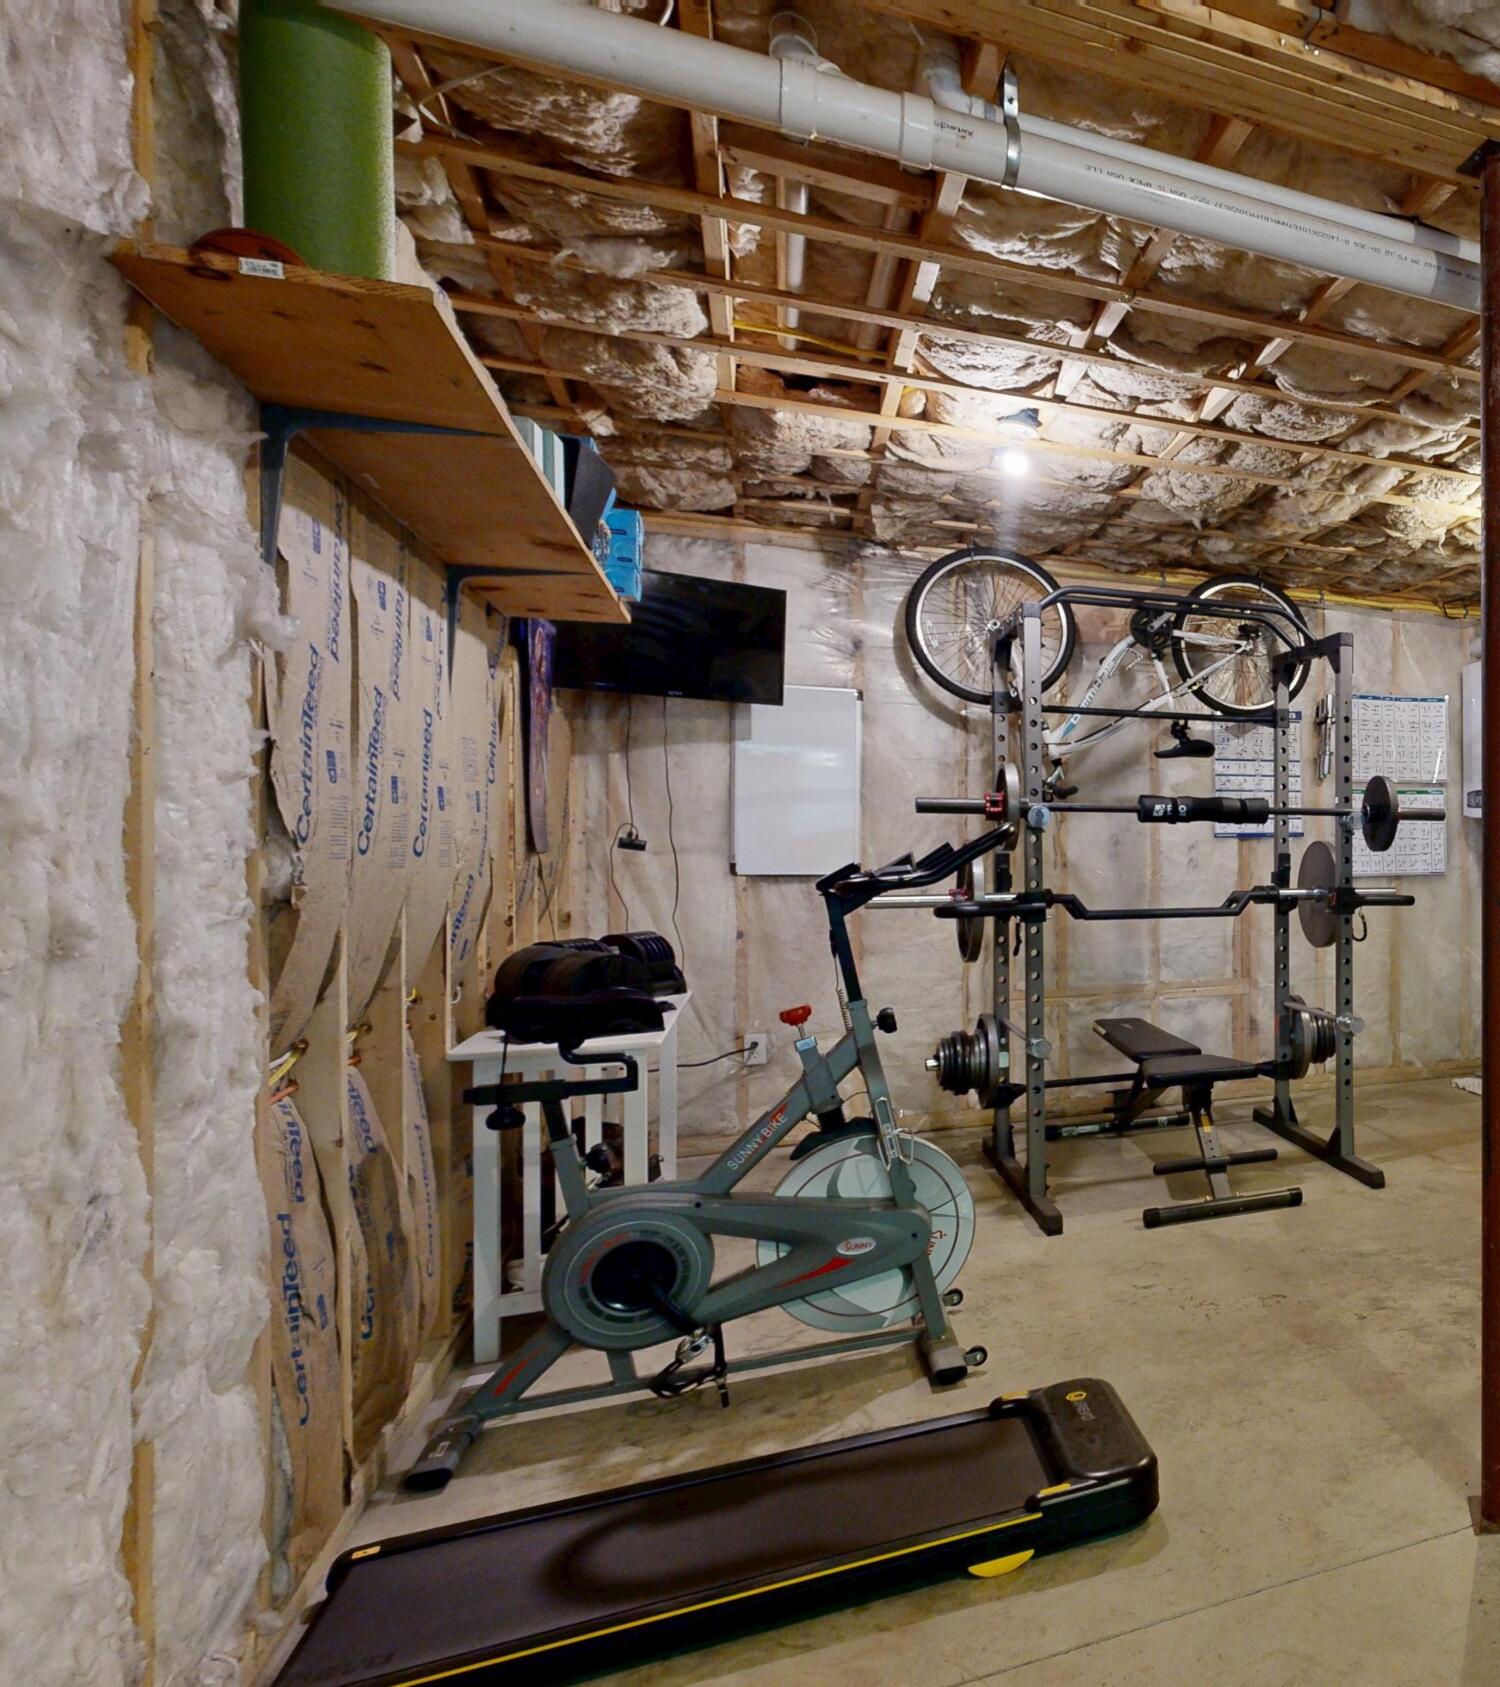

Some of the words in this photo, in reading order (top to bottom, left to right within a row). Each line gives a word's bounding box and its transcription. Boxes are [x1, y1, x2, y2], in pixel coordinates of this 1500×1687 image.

[297, 642, 319, 844] CertainTeed
[357, 685, 384, 857] CertainTeed
[726, 1134, 763, 1171] SUNNY
[760, 1112, 789, 1139] BIKE
[275, 1213, 310, 1427] CertainTeed
[843, 1237, 874, 1253] SUNNY
